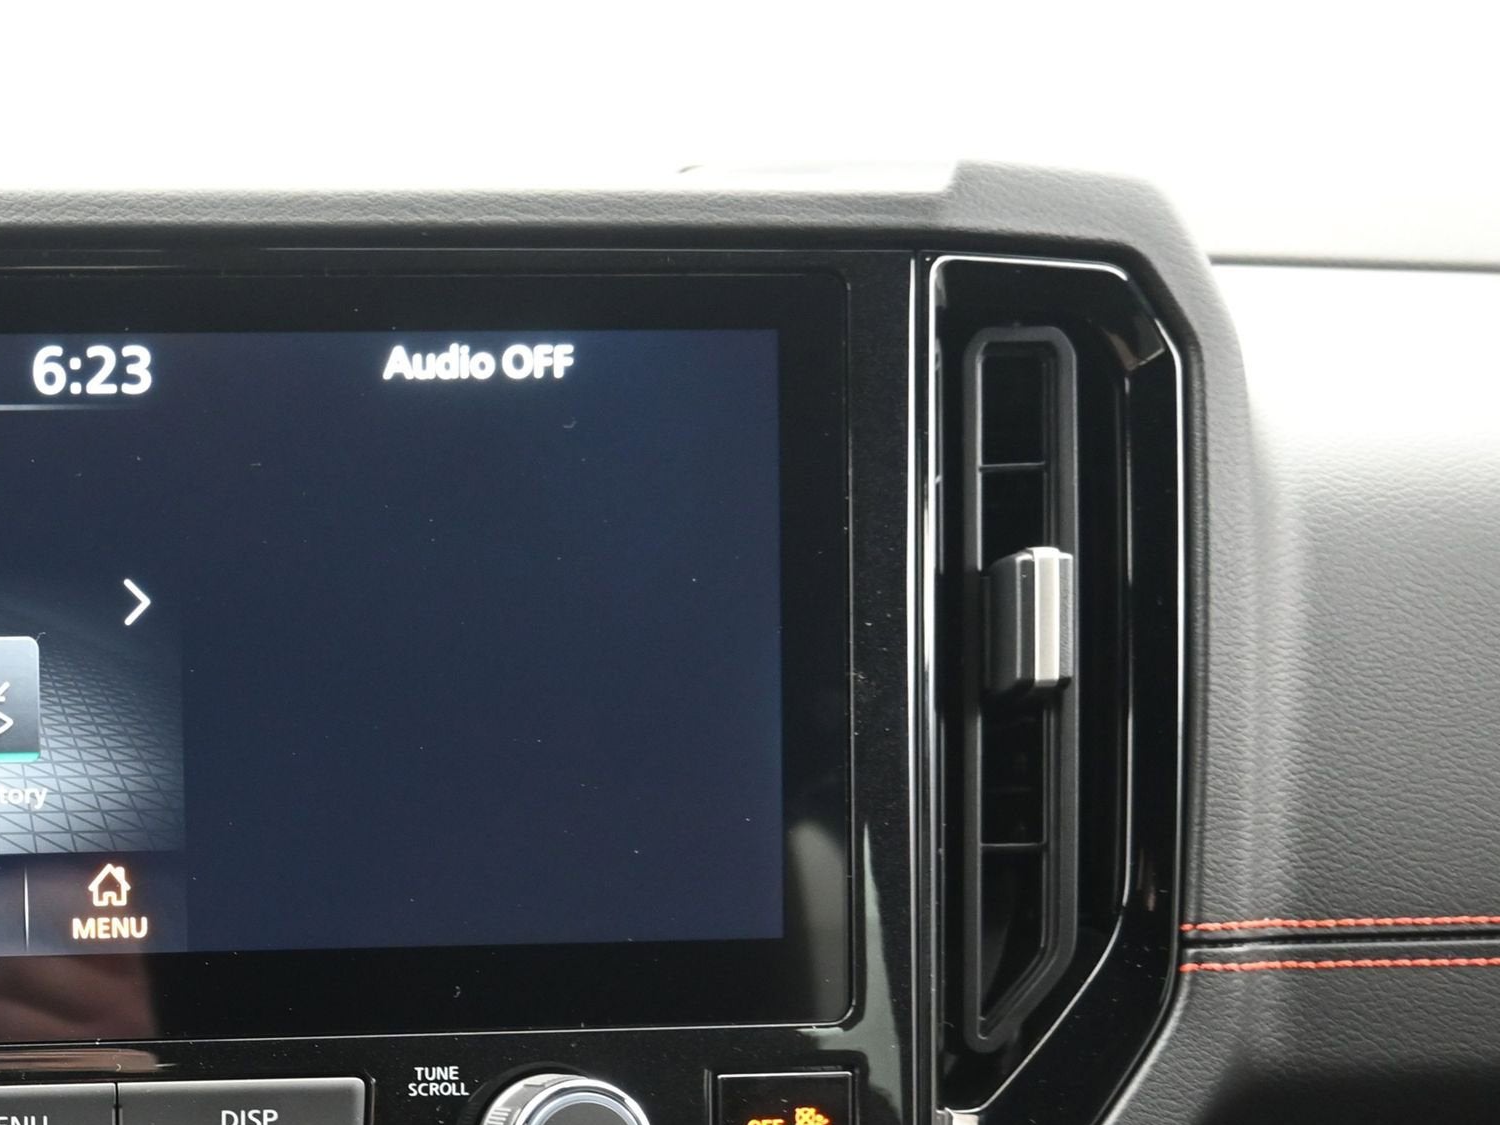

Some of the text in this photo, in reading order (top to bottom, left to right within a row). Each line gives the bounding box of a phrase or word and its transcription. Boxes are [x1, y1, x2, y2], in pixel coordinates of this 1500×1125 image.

[32, 344, 153, 396] 6:23
[382, 342, 575, 381] Audio OFF
[71, 916, 148, 940] MENU
[414, 1065, 460, 1081] TUNE
[408, 1081, 470, 1097] SCROLL
